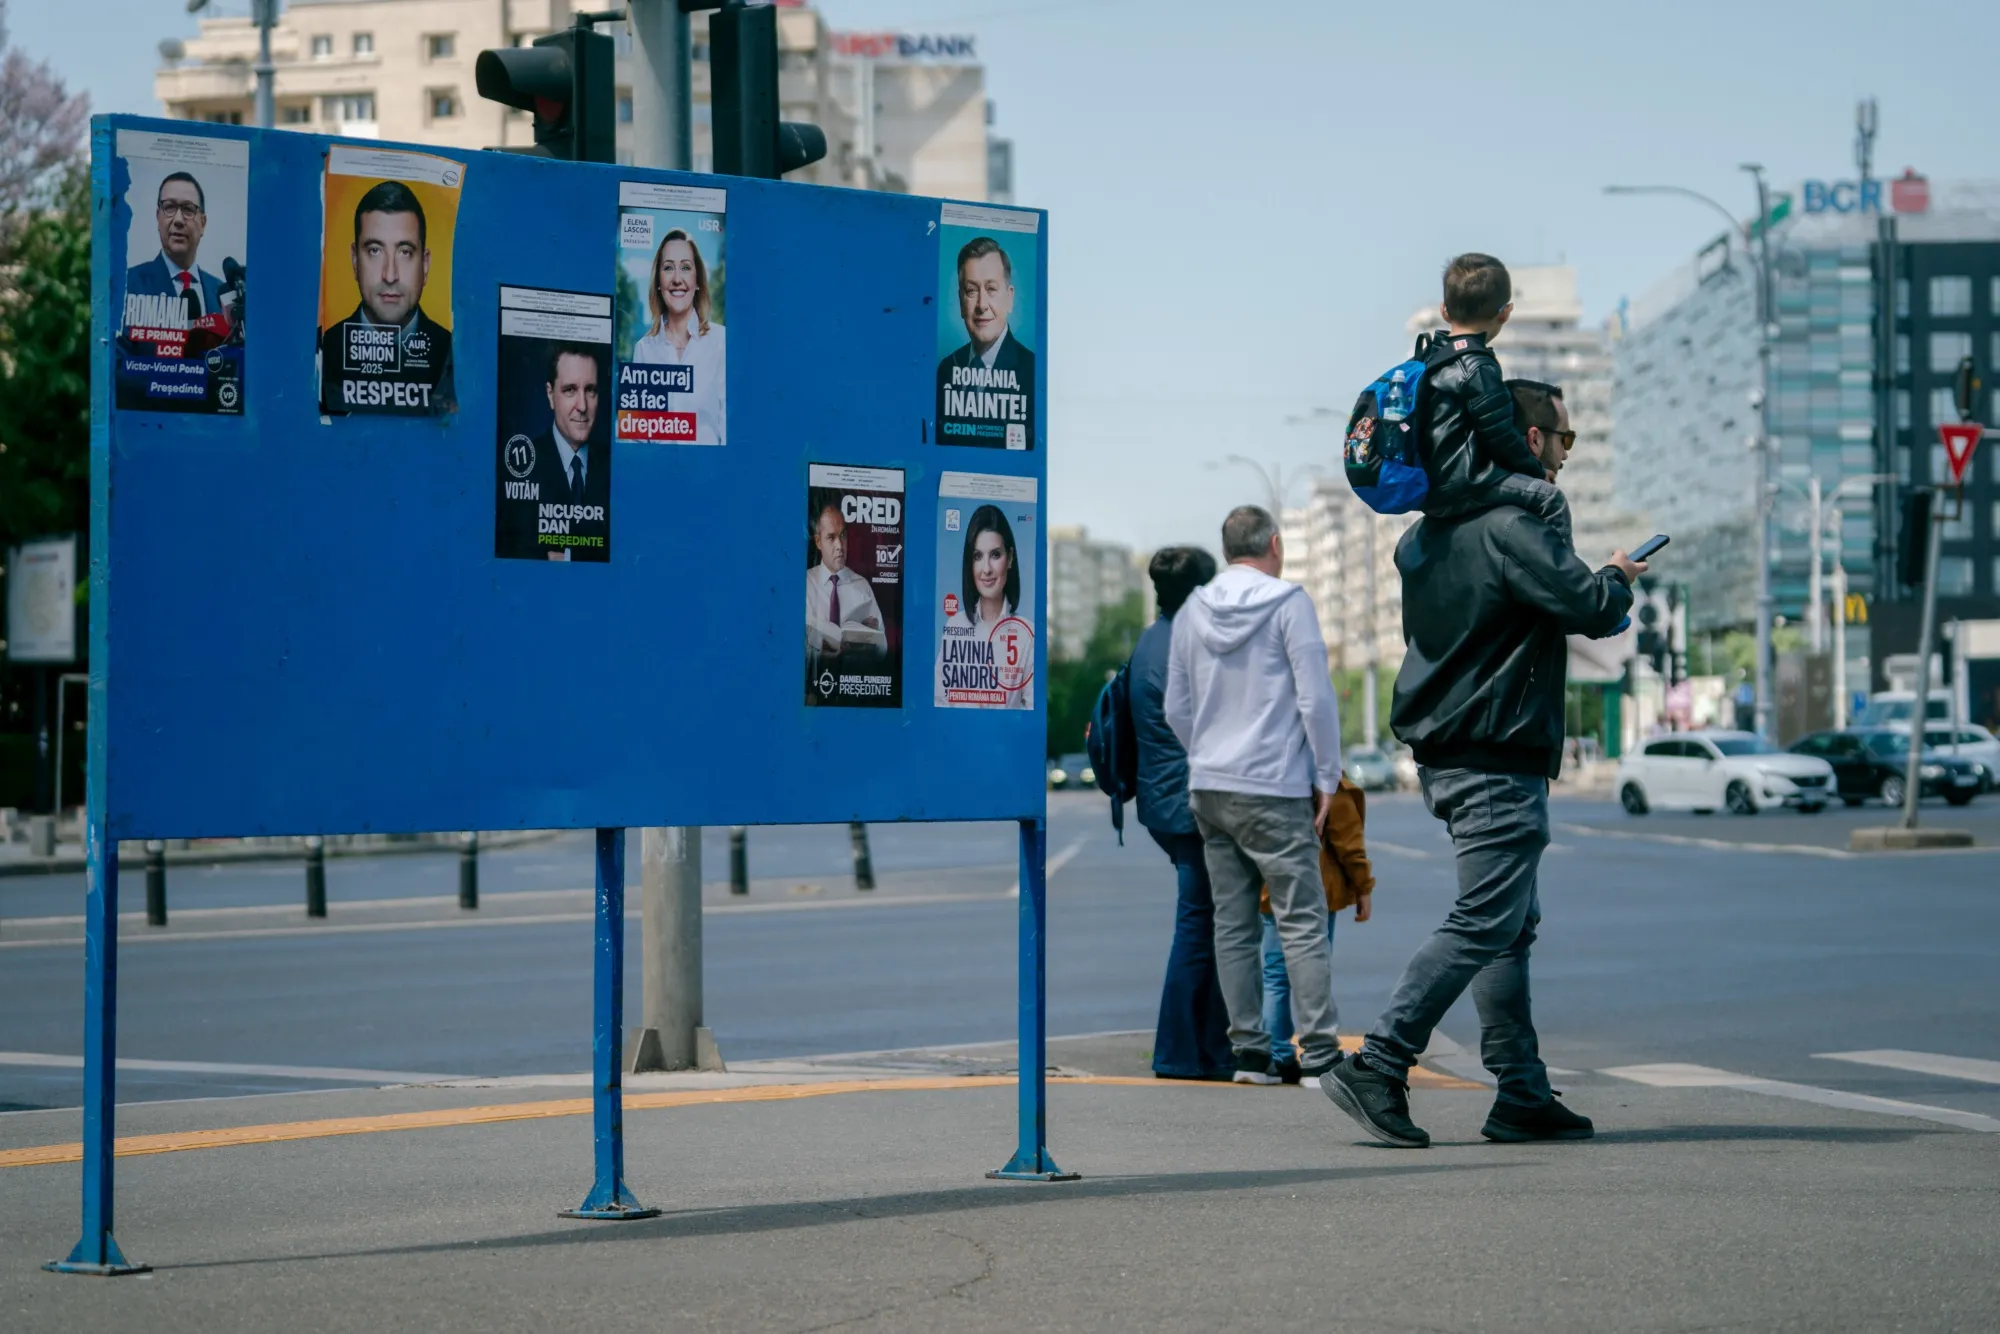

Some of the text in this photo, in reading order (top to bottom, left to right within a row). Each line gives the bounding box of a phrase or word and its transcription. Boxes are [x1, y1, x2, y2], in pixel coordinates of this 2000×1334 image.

[1804, 181, 1882, 213] BCR
[627, 218, 647, 226] ELENA
[623, 226, 651, 234] LASCONI
[125, 292, 189, 330] ROMÂNIA
[131, 329, 185, 342] PE PRIMUL
[350, 329, 395, 346] GEORGE
[157, 345, 182, 356] LOC!
[408, 339, 426, 350] AUR
[350, 345, 395, 362] SIMION
[125, 361, 204, 375] Victor-Viorel Ponta
[361, 363, 383, 374] 2025
[620, 365, 691, 391] Am curaj
[952, 365, 1020, 392] ROMÂNIA,
[150, 381, 204, 396] Președinte
[223, 391, 233, 400] VP
[343, 380, 432, 407] RESPECT
[620, 389, 666, 410] să fac
[943, 382, 1027, 421] ÎNAINTE!
[620, 413, 693, 438] dreptate.
[943, 422, 977, 436] CRIN
[512, 445, 527, 466] 11
[505, 480, 539, 501] VOTĂM
[538, 503, 604, 524] NICUȘOR
[841, 494, 901, 525] CRED
[538, 519, 570, 534] DAN
[538, 534, 604, 548] PREȘEDINTE
[876, 549, 886, 563] 10
[944, 599, 957, 608] STOP
[943, 639, 995, 664] LAVINIA
[1006, 635, 1018, 666] 5
[839, 675, 892, 684] DANIEL FUNERIU
[839, 683, 892, 697] PREȘEDINTE
[949, 691, 967, 701] PENTRU
